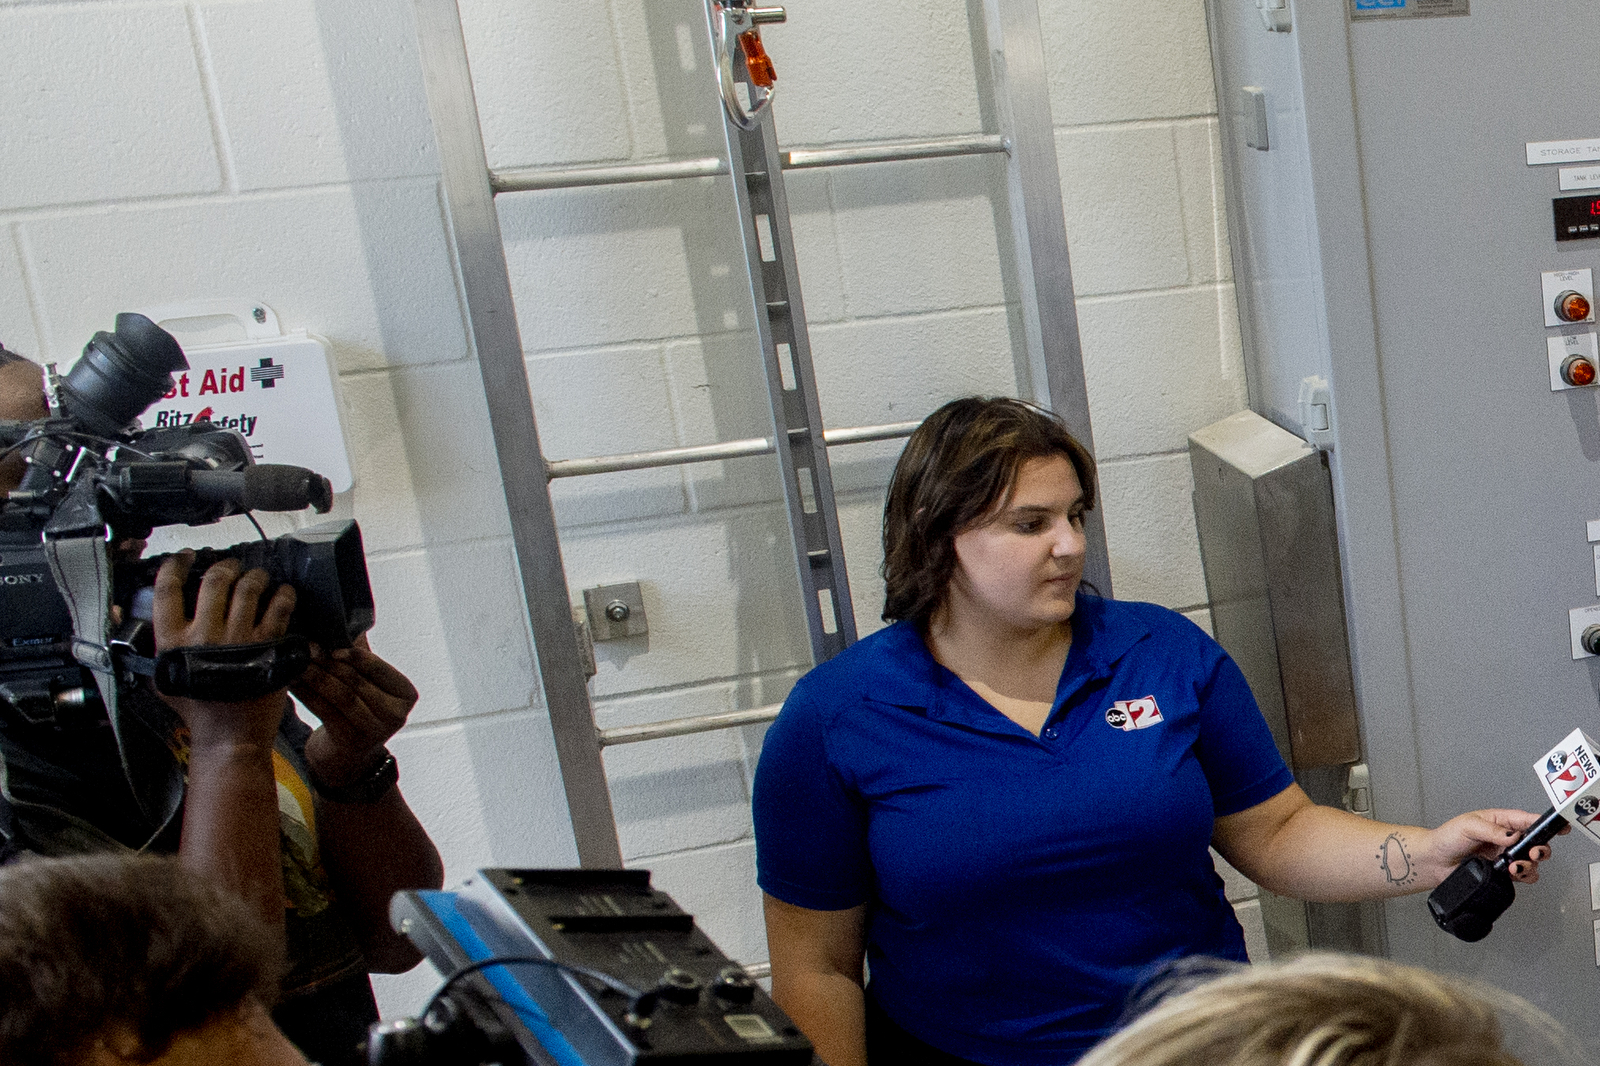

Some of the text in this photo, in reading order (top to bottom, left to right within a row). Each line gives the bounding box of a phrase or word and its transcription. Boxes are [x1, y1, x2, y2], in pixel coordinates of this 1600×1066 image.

[1540, 147, 1581, 157] STORAGE
[198, 366, 245, 396] Aid
[155, 410, 193, 428] Ritz
[1107, 712, 1127, 723] abc
[1550, 752, 1564, 772] abc
[1574, 744, 1597, 779] NEWS
[1577, 798, 1597, 814] abc
